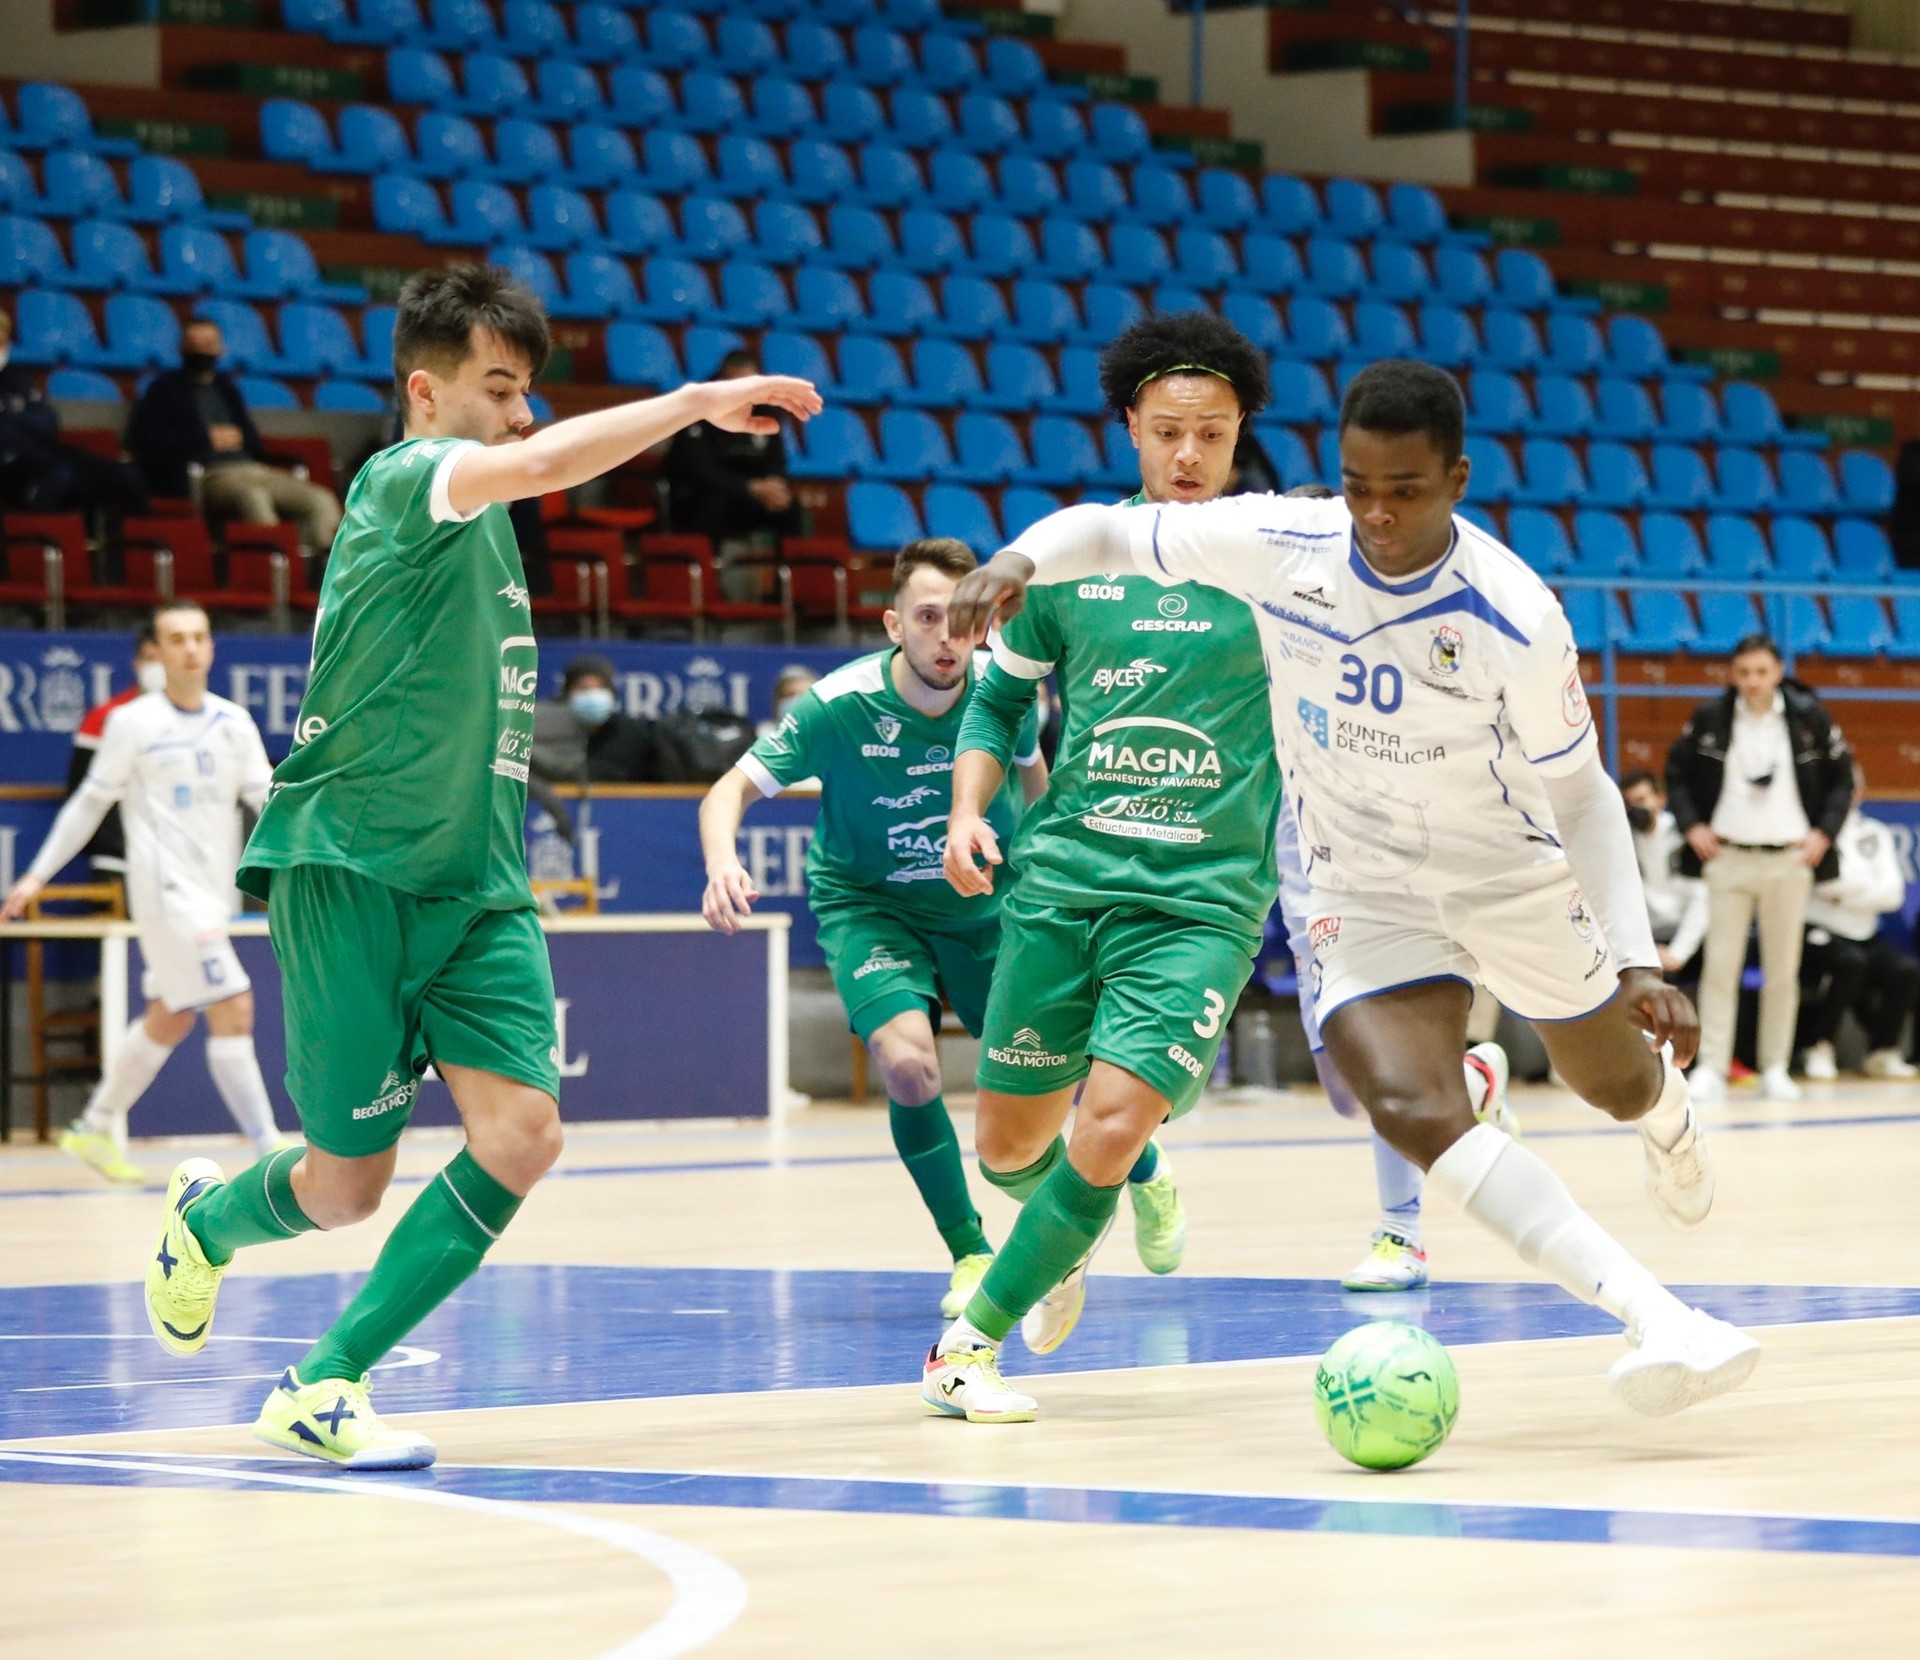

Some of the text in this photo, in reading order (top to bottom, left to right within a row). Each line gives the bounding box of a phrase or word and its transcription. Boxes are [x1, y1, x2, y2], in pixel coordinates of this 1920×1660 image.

[1078, 584, 1125, 601] GIOS
[1131, 619, 1213, 633] GESCRAP
[1091, 668, 1146, 695] ABYCER
[1335, 653, 1403, 715] 30
[1336, 718, 1401, 749] XUNTA
[861, 744, 900, 758] GIOS
[1087, 741, 1222, 775] MAGNA
[1336, 734, 1446, 765] DE GALICIA
[1087, 770, 1221, 789] MAGNESITAS NAVARRAS
[1089, 818, 1143, 836] Estructuras
[1192, 987, 1226, 1039] 3
[988, 1047, 1068, 1068] BEOLA MOTOR
[1167, 1044, 1204, 1078] GIOS
[352, 1102, 389, 1120] BEOLA
